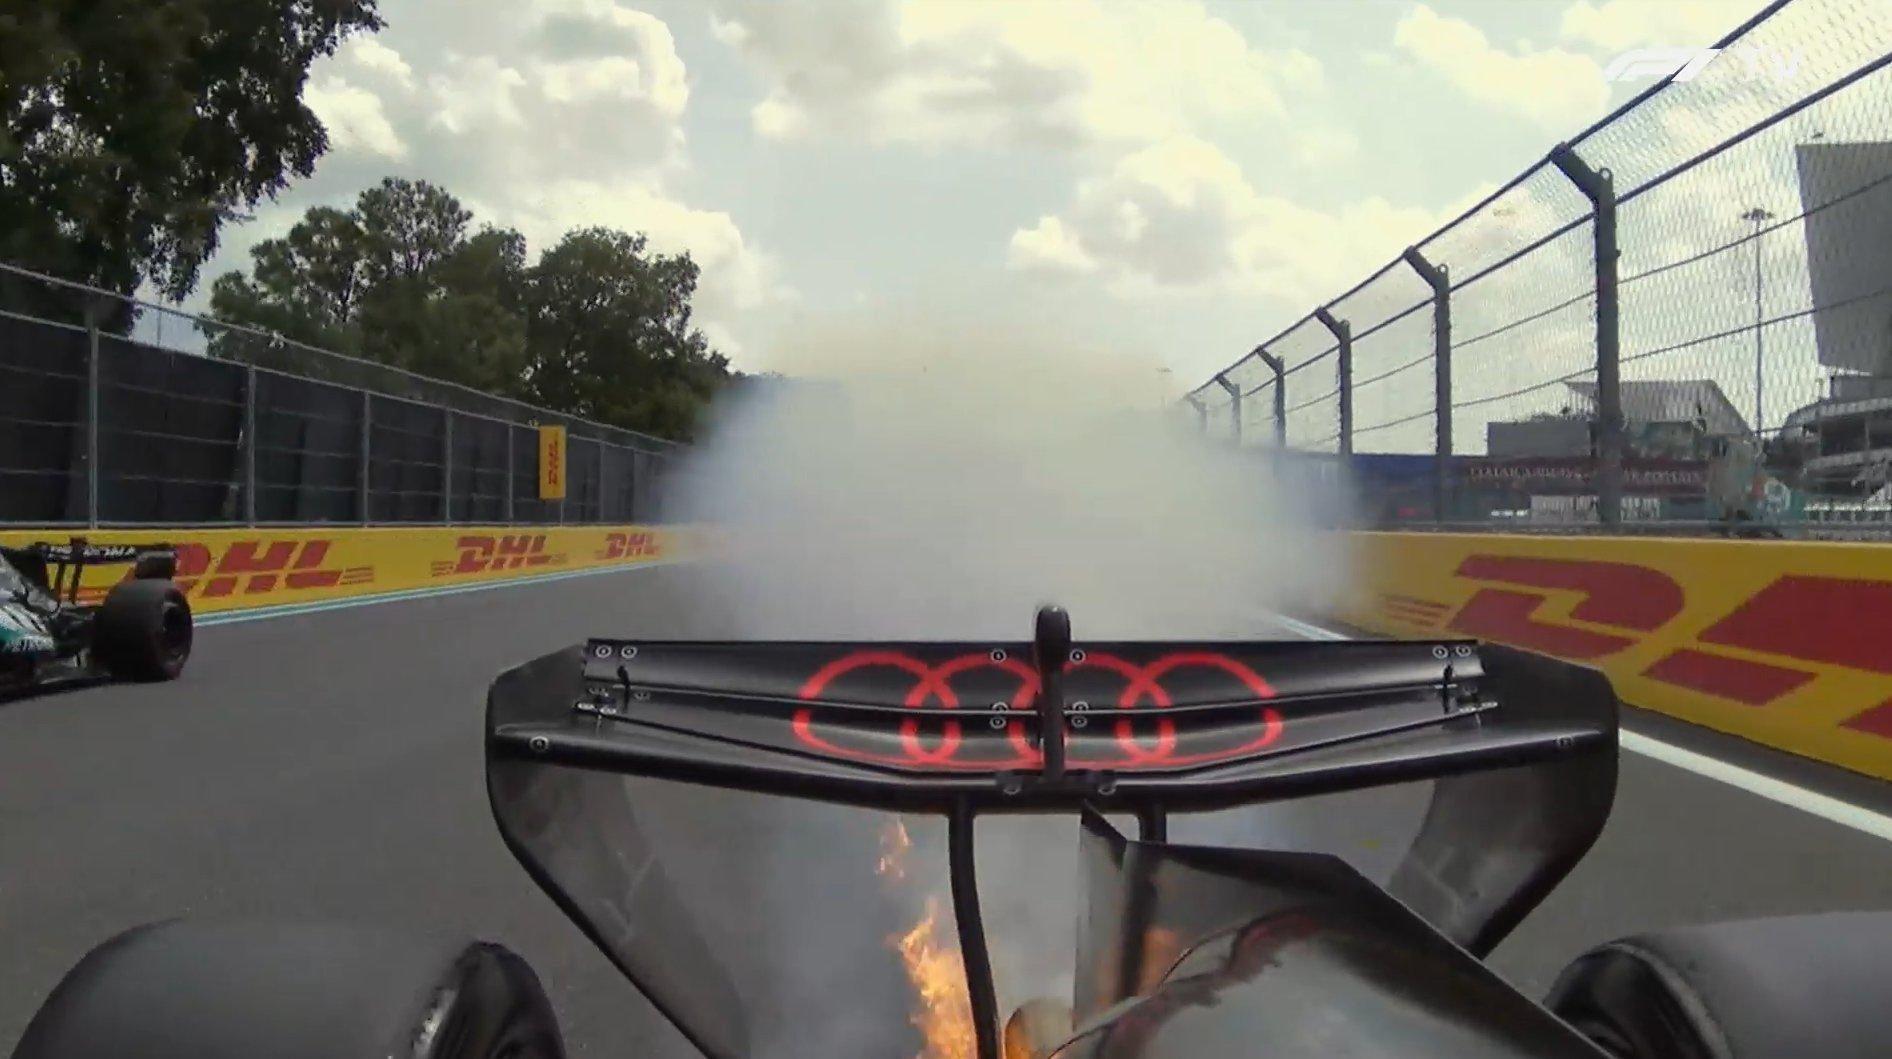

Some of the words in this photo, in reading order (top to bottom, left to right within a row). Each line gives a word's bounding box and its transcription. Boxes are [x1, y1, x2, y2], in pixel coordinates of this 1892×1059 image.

[547, 440, 559, 485] DHL
[454, 535, 558, 572] DHL
[602, 533, 661, 560] DHL
